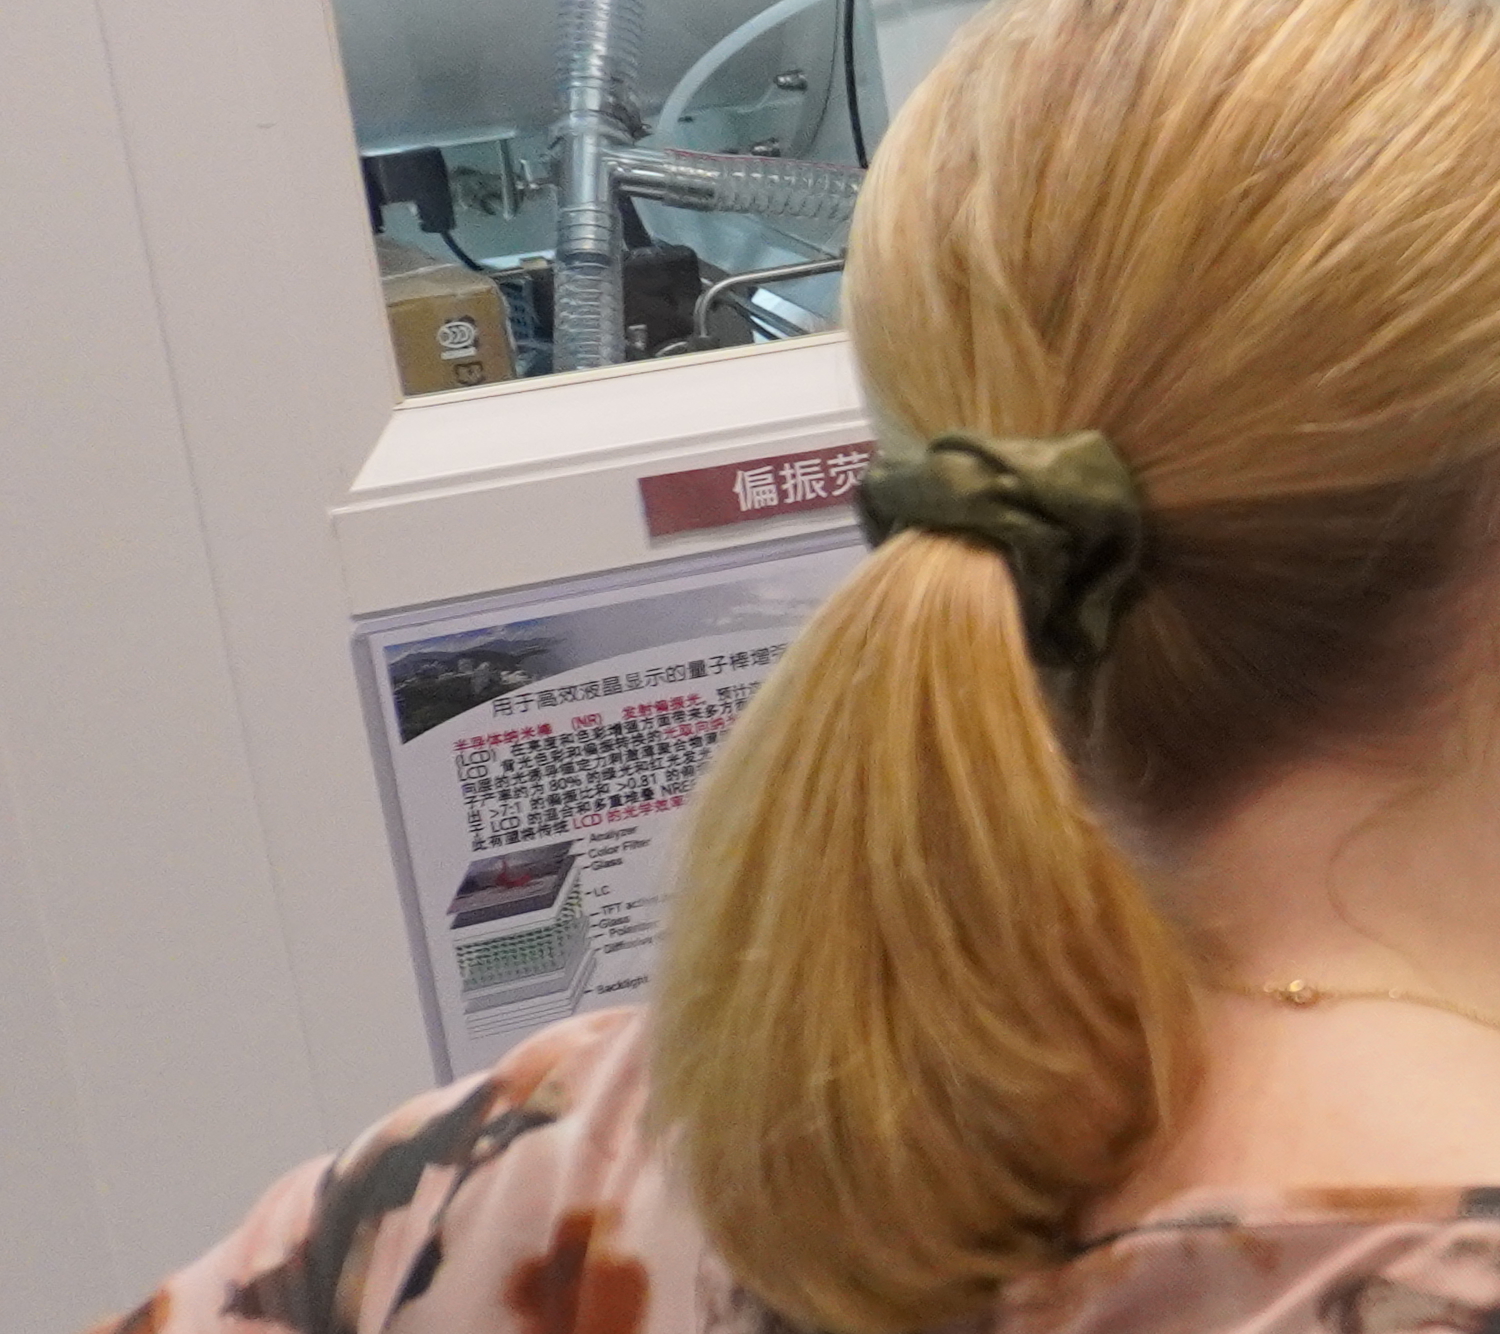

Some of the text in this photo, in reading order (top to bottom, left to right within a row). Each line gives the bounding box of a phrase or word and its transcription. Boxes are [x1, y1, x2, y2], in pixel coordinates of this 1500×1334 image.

[572, 813, 603, 830] LCD
[588, 845, 620, 858] Color
[594, 886, 610, 897] LC
[602, 902, 622, 913] TFT
